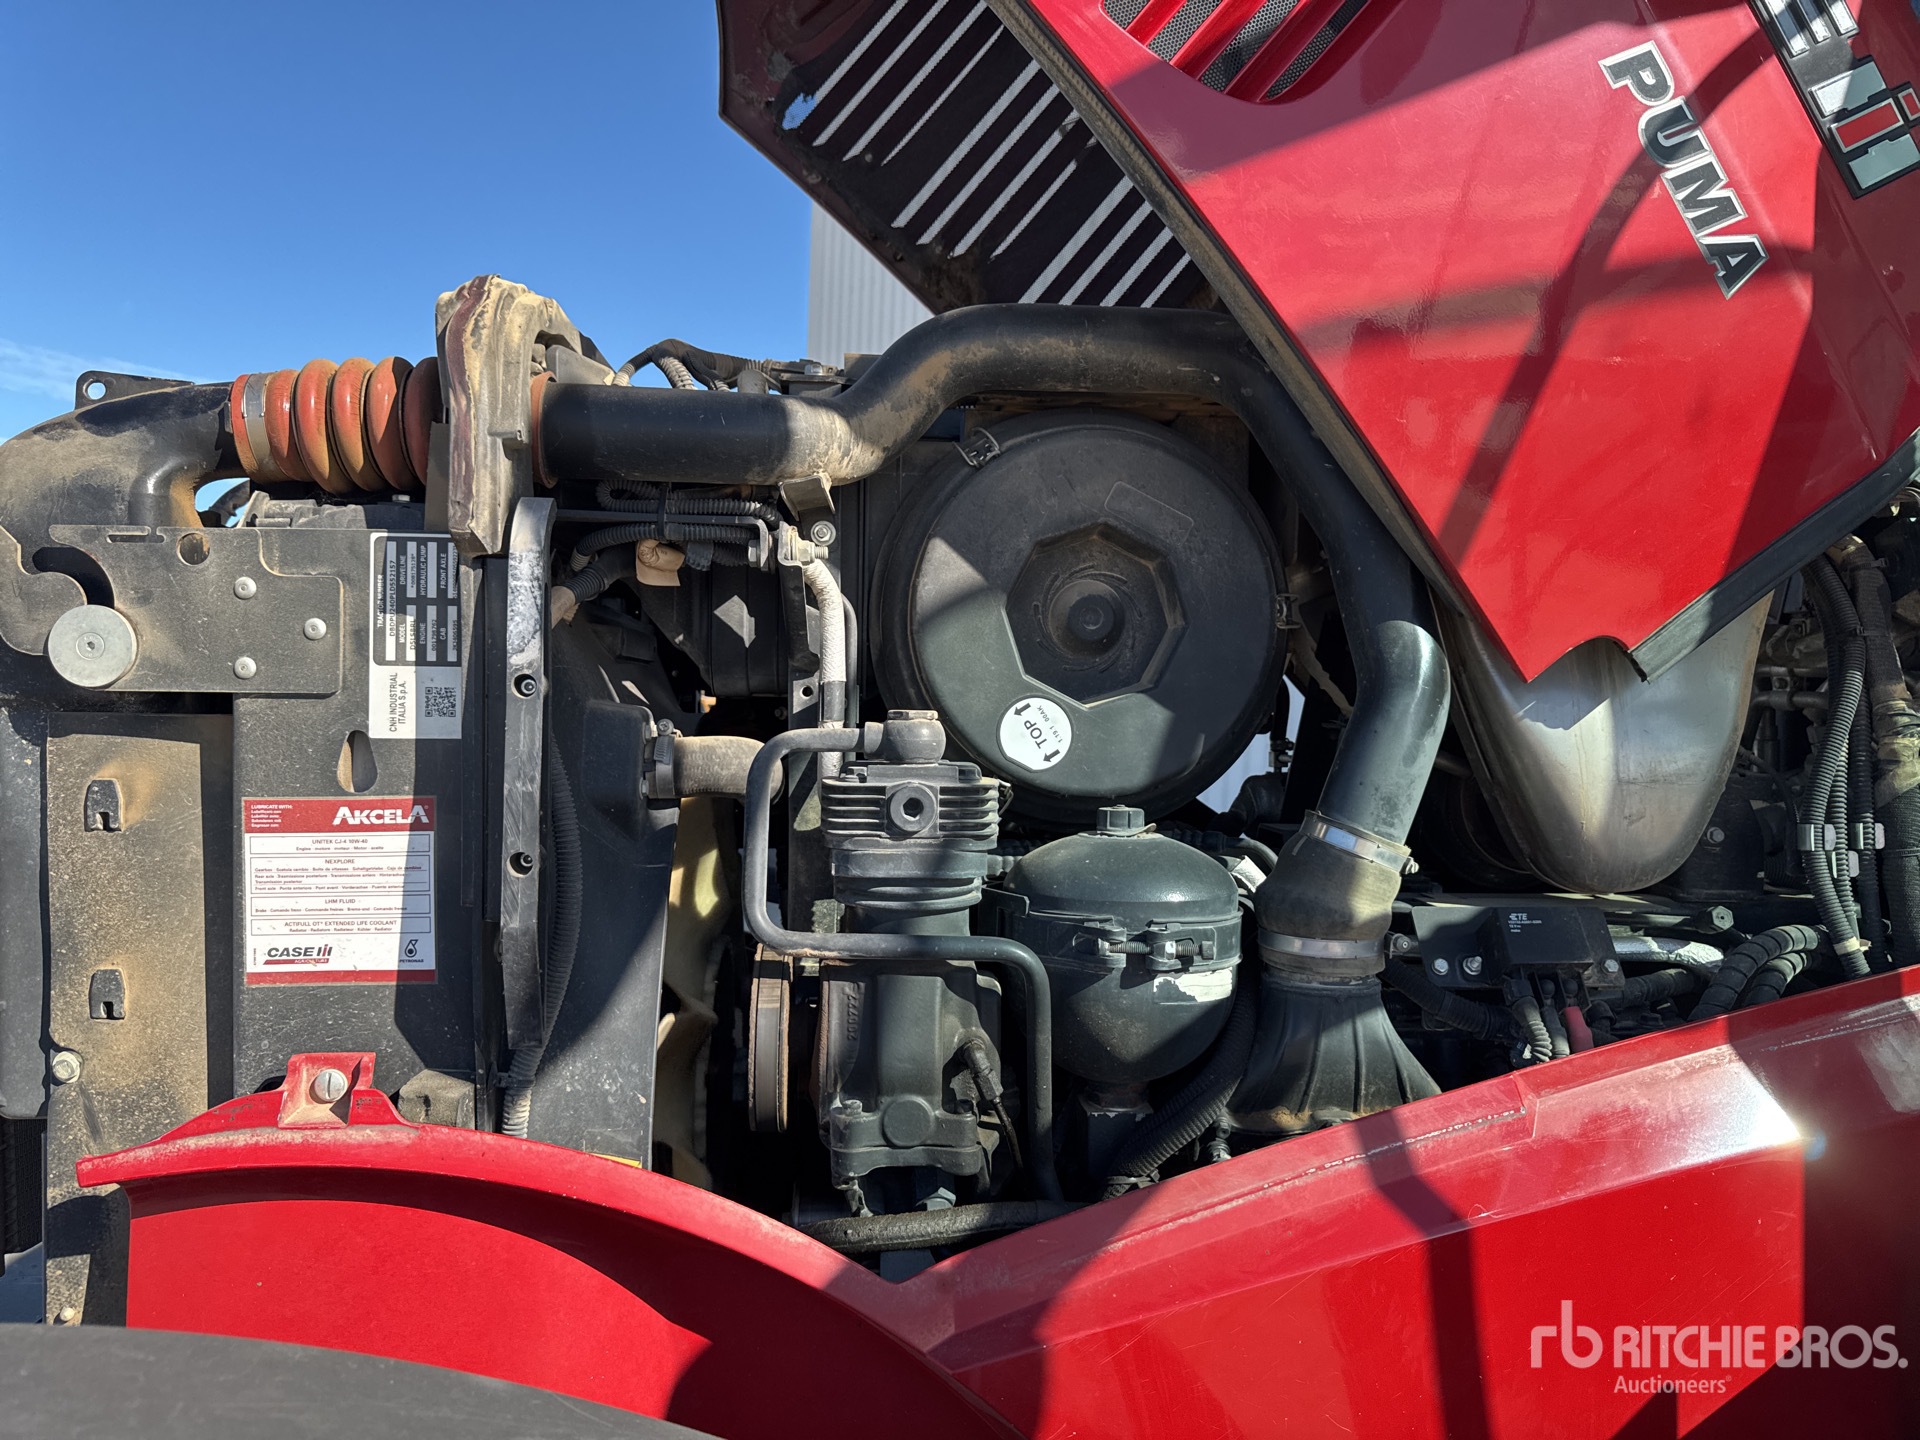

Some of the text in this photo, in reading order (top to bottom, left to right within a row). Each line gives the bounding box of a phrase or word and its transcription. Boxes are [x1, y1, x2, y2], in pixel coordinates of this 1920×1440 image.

[1598, 40, 1769, 300] PUMA
[1024, 720, 1047, 749] TOP
[267, 947, 315, 958] CASE
